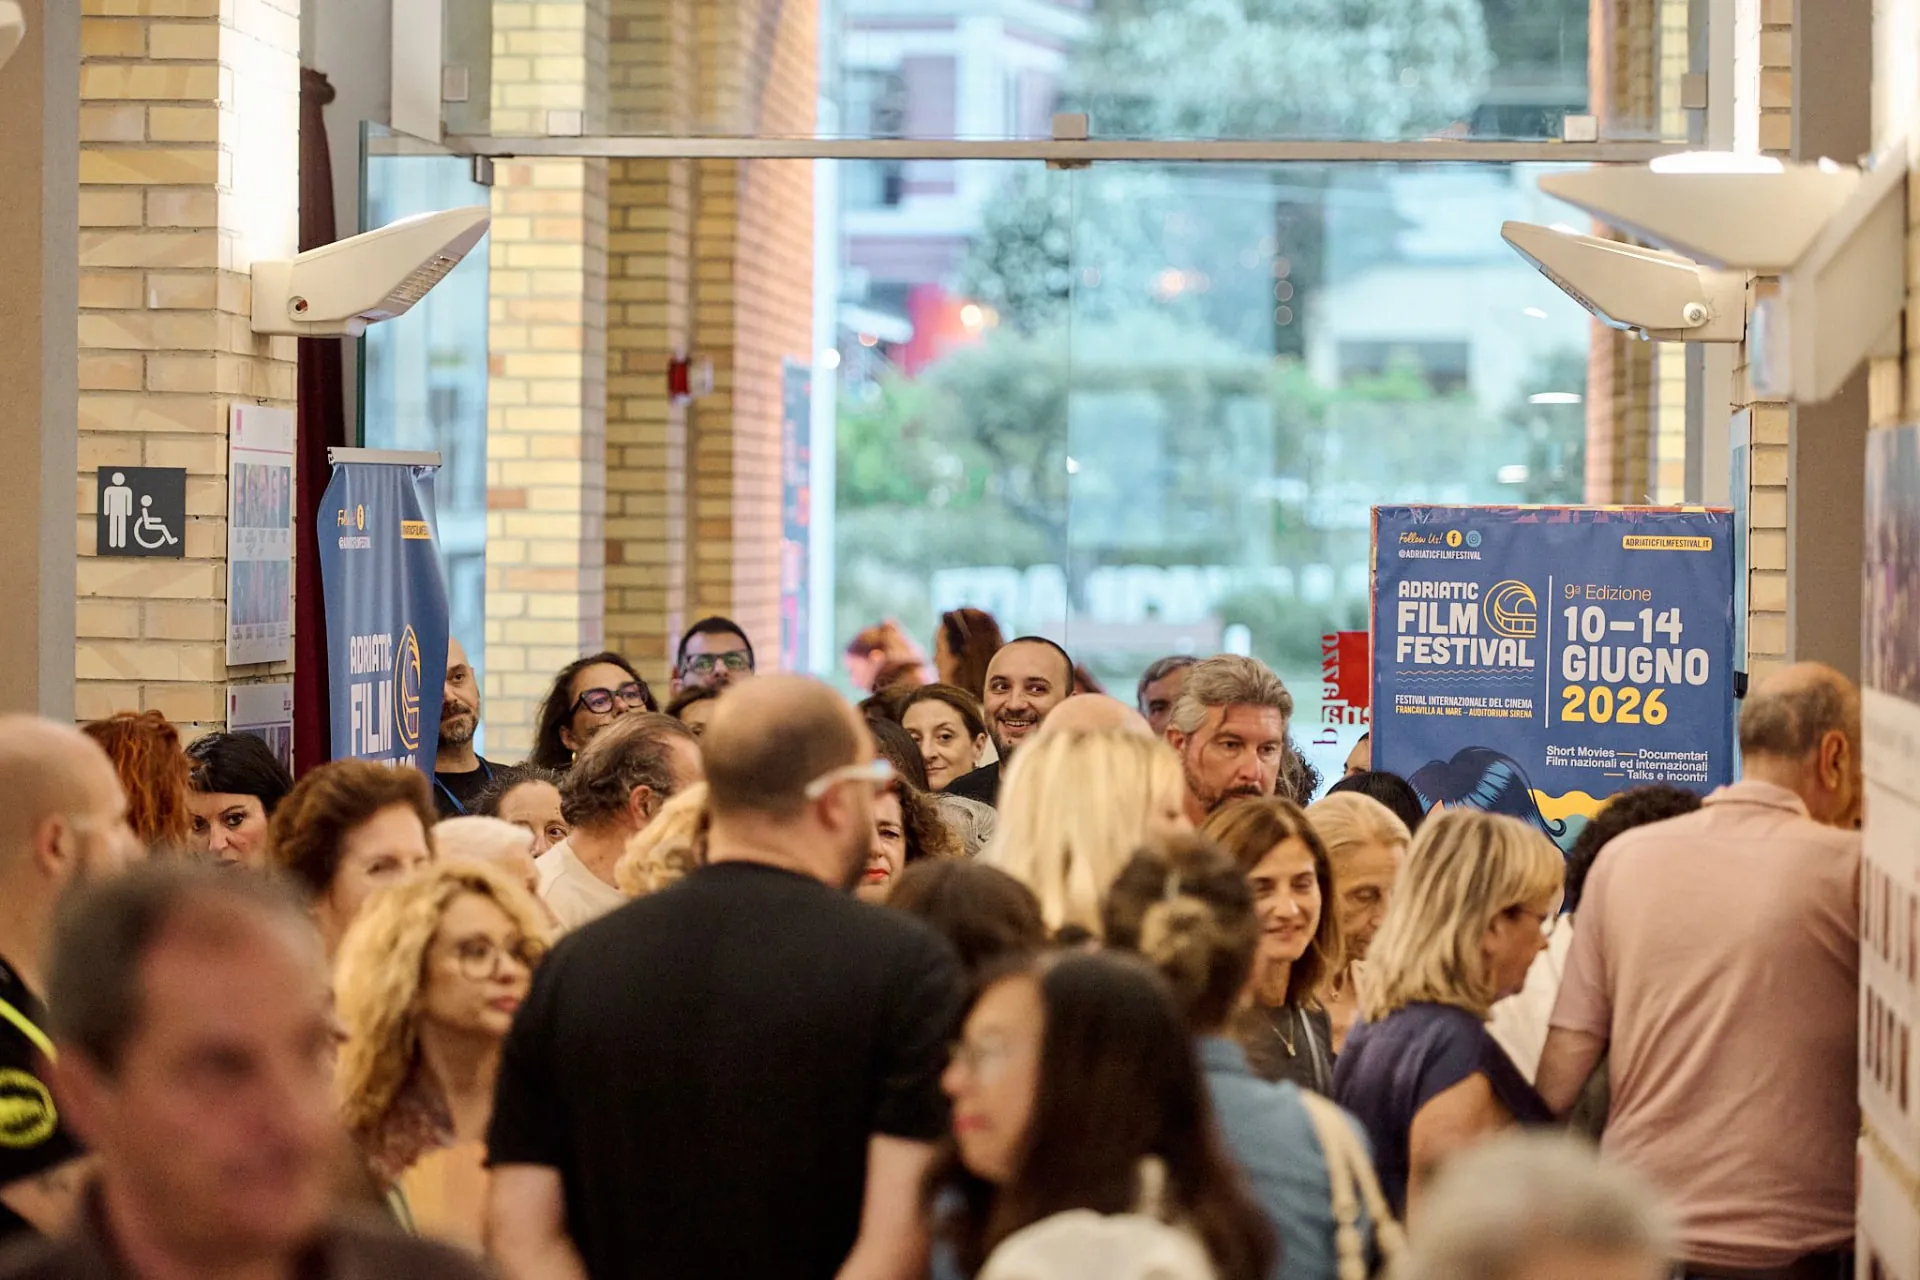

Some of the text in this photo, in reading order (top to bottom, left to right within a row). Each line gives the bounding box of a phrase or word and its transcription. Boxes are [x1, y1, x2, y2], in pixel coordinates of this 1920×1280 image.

[1399, 532, 1426, 545] Follow
[1428, 532, 1444, 545] Us!
[1625, 538, 1709, 549] ADRIATICFILMFESTIVAL.IT
[1398, 550, 1482, 560] @ADRIATICFILMFESTIVAL
[1398, 580, 1479, 600] ADRIATIC
[1585, 584, 1652, 601] Edizione
[1397, 600, 1479, 635] FILM
[350, 633, 392, 675] ADRIATIC
[1396, 635, 1536, 667] FESTIVAL
[1562, 644, 1710, 686] GIUGNO
[1395, 694, 1533, 710] FESTIVAL INTERNAZIONALE DEL CINEMA
[1561, 684, 1669, 726] 2026
[350, 680, 392, 757] FILM
[1395, 705, 1436, 716] FRANCAVILLA
[1436, 706, 1444, 716] AL
[1444, 707, 1462, 717] MARE
[1468, 708, 1508, 719] AUDITORIUM
[1509, 709, 1533, 719] SIRENA
[1546, 745, 1708, 761] Short Movies Documentari
[1545, 756, 1708, 772] Film nazionali ed internazionali
[1626, 769, 1708, 783] Talks e incontri
